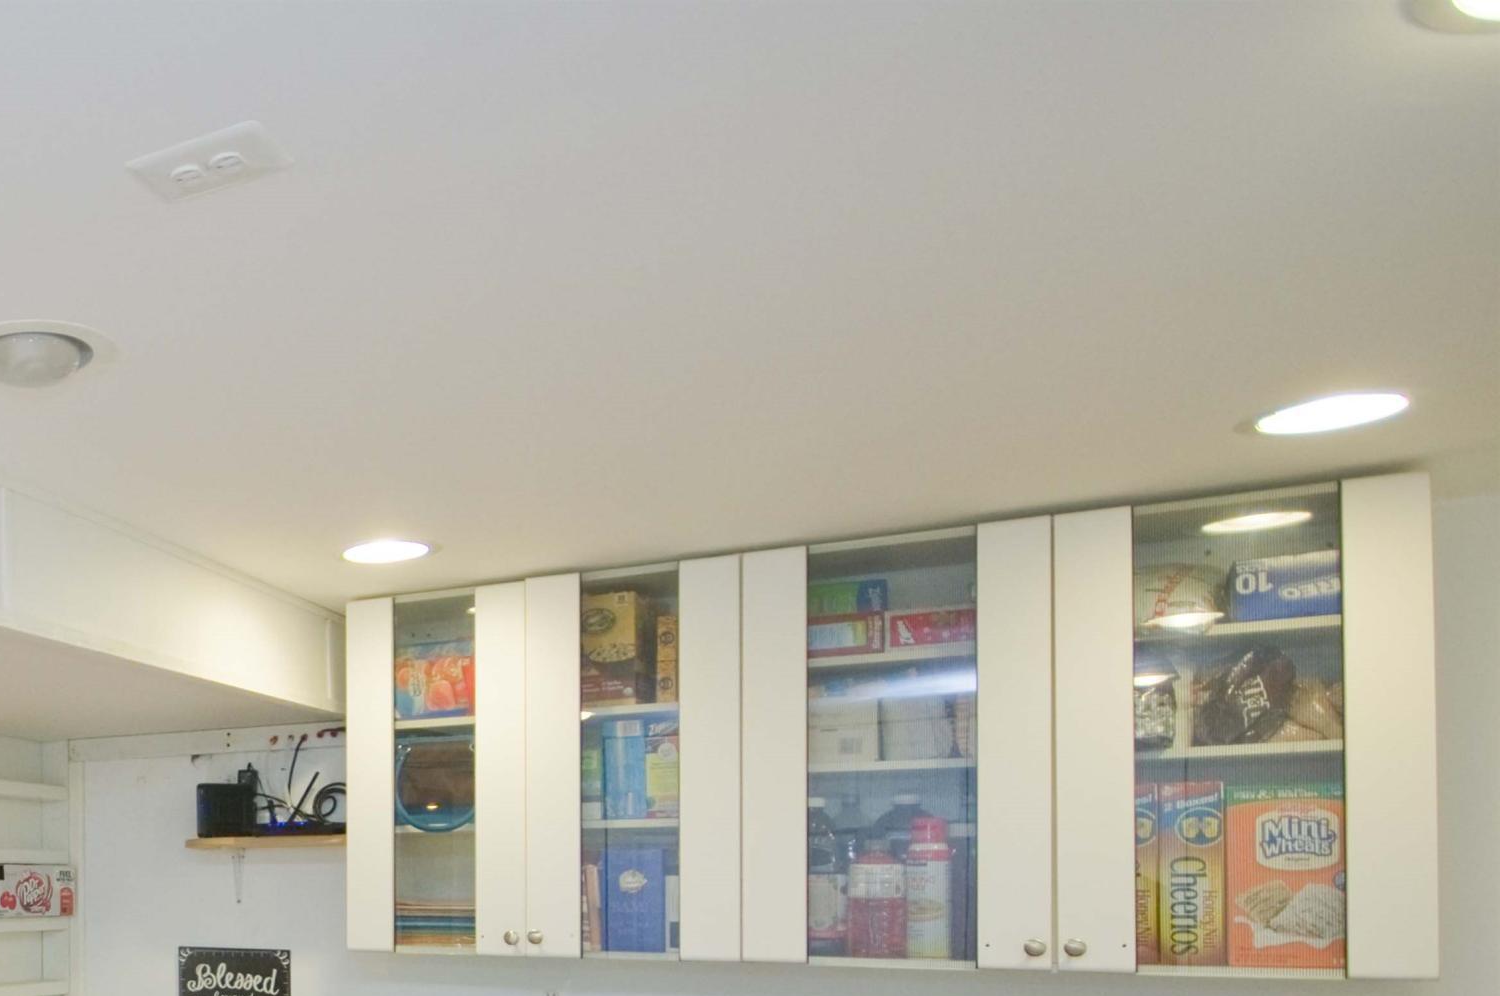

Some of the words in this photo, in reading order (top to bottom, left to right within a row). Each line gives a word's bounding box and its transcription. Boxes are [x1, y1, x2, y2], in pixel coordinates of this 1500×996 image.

[1262, 815, 1330, 841] Mini
[1262, 838, 1332, 859] Wheats
[1170, 856, 1208, 956] Cheerios
[187, 963, 280, 996] Blessed
